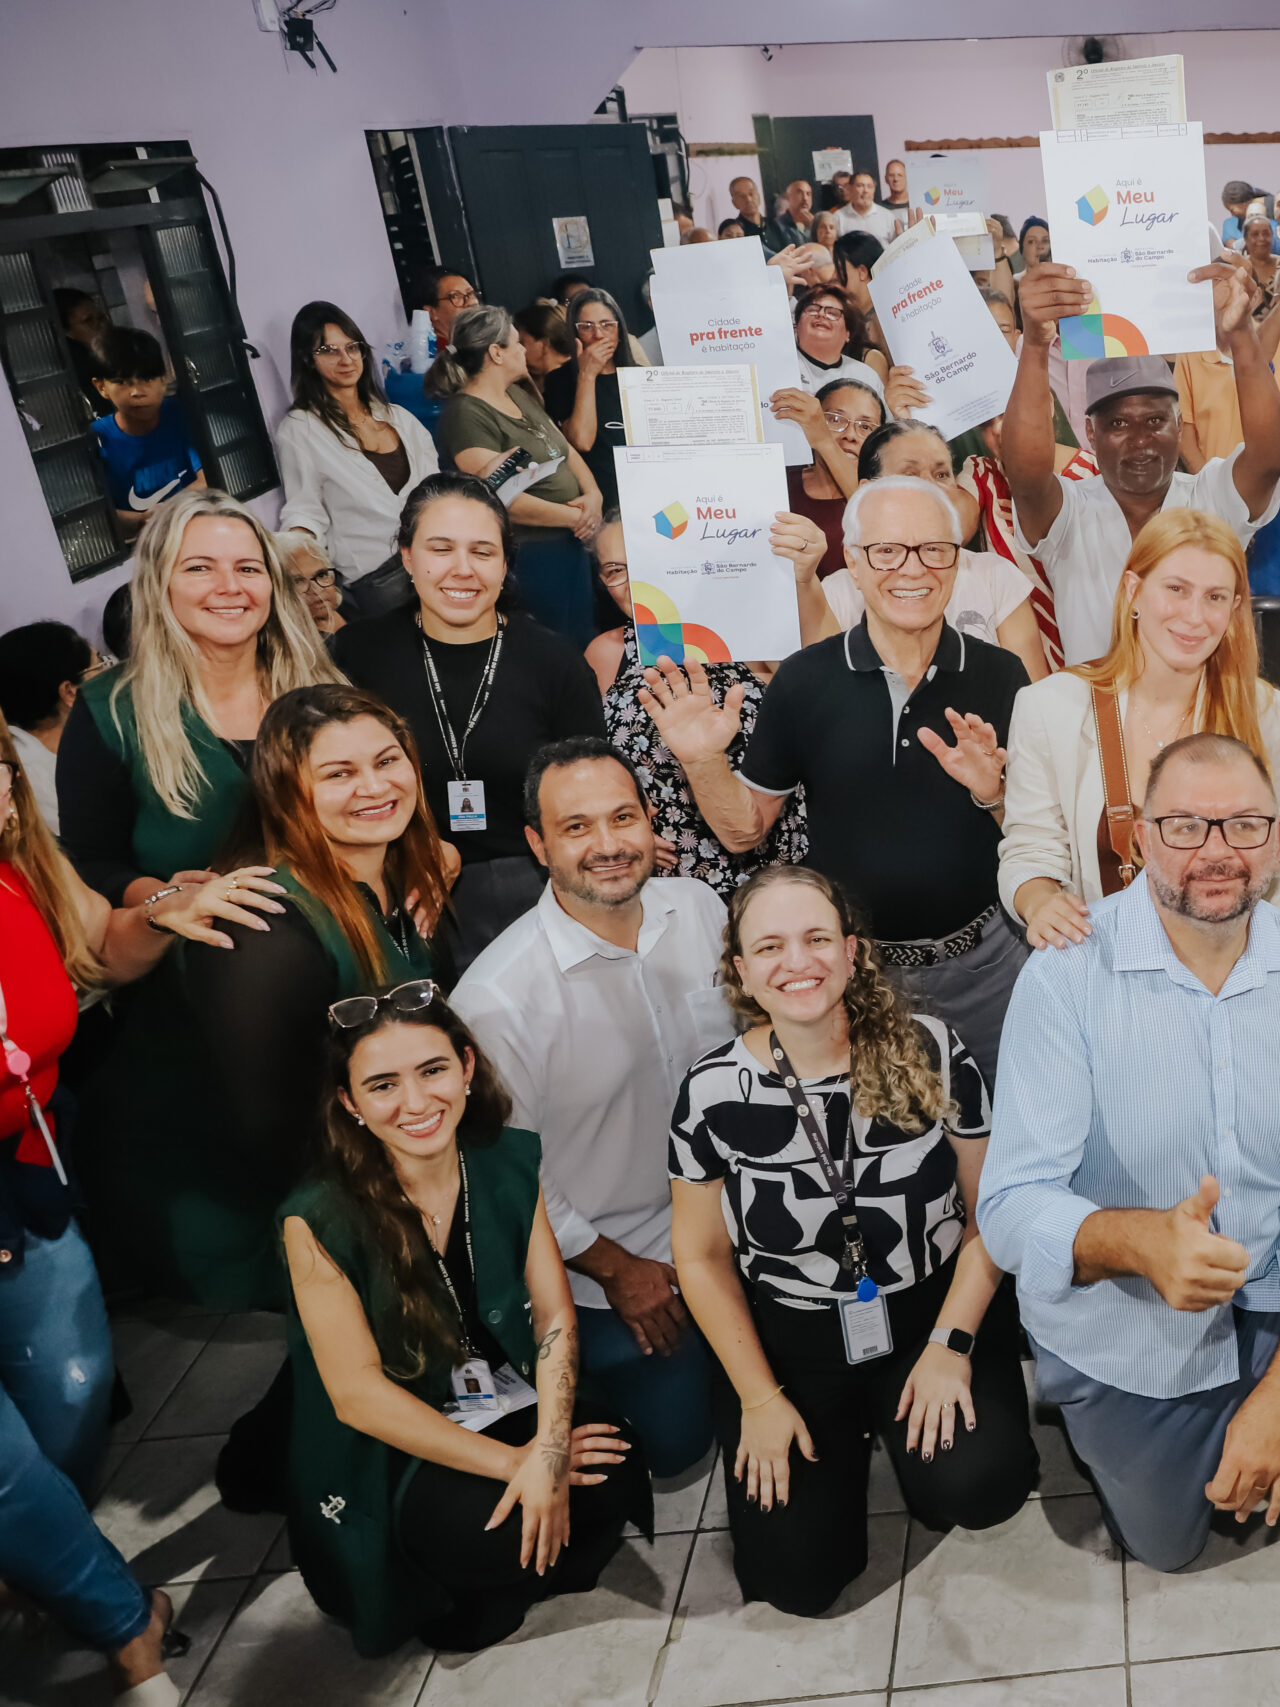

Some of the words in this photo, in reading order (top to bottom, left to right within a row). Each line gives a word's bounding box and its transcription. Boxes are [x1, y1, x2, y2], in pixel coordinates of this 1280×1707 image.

[1116, 178, 1134, 188] Aqui
[1136, 178, 1142, 186] é
[944, 188, 964, 196] Meu
[1116, 190, 1154, 204] Meu
[1120, 206, 1179, 230] Lugar
[898, 277, 922, 294] Cidade
[892, 298, 908, 318] pra
[907, 279, 944, 302] frente
[906, 297, 942, 320] habitação
[708, 317, 741, 326] Cidade
[690, 331, 716, 346] pra
[718, 326, 764, 340] frente
[709, 342, 756, 352] habitação
[924, 370, 940, 381] São
[940, 352, 977, 374] Bernardo
[936, 376, 945, 384] do
[946, 361, 974, 378] Campo
[696, 496, 716, 505] Aqui
[696, 506, 736, 520] Meu
[700, 522, 762, 545] Lugar
[666, 568, 698, 576] Habitação
[492, 638, 502, 662] BERNARDO
